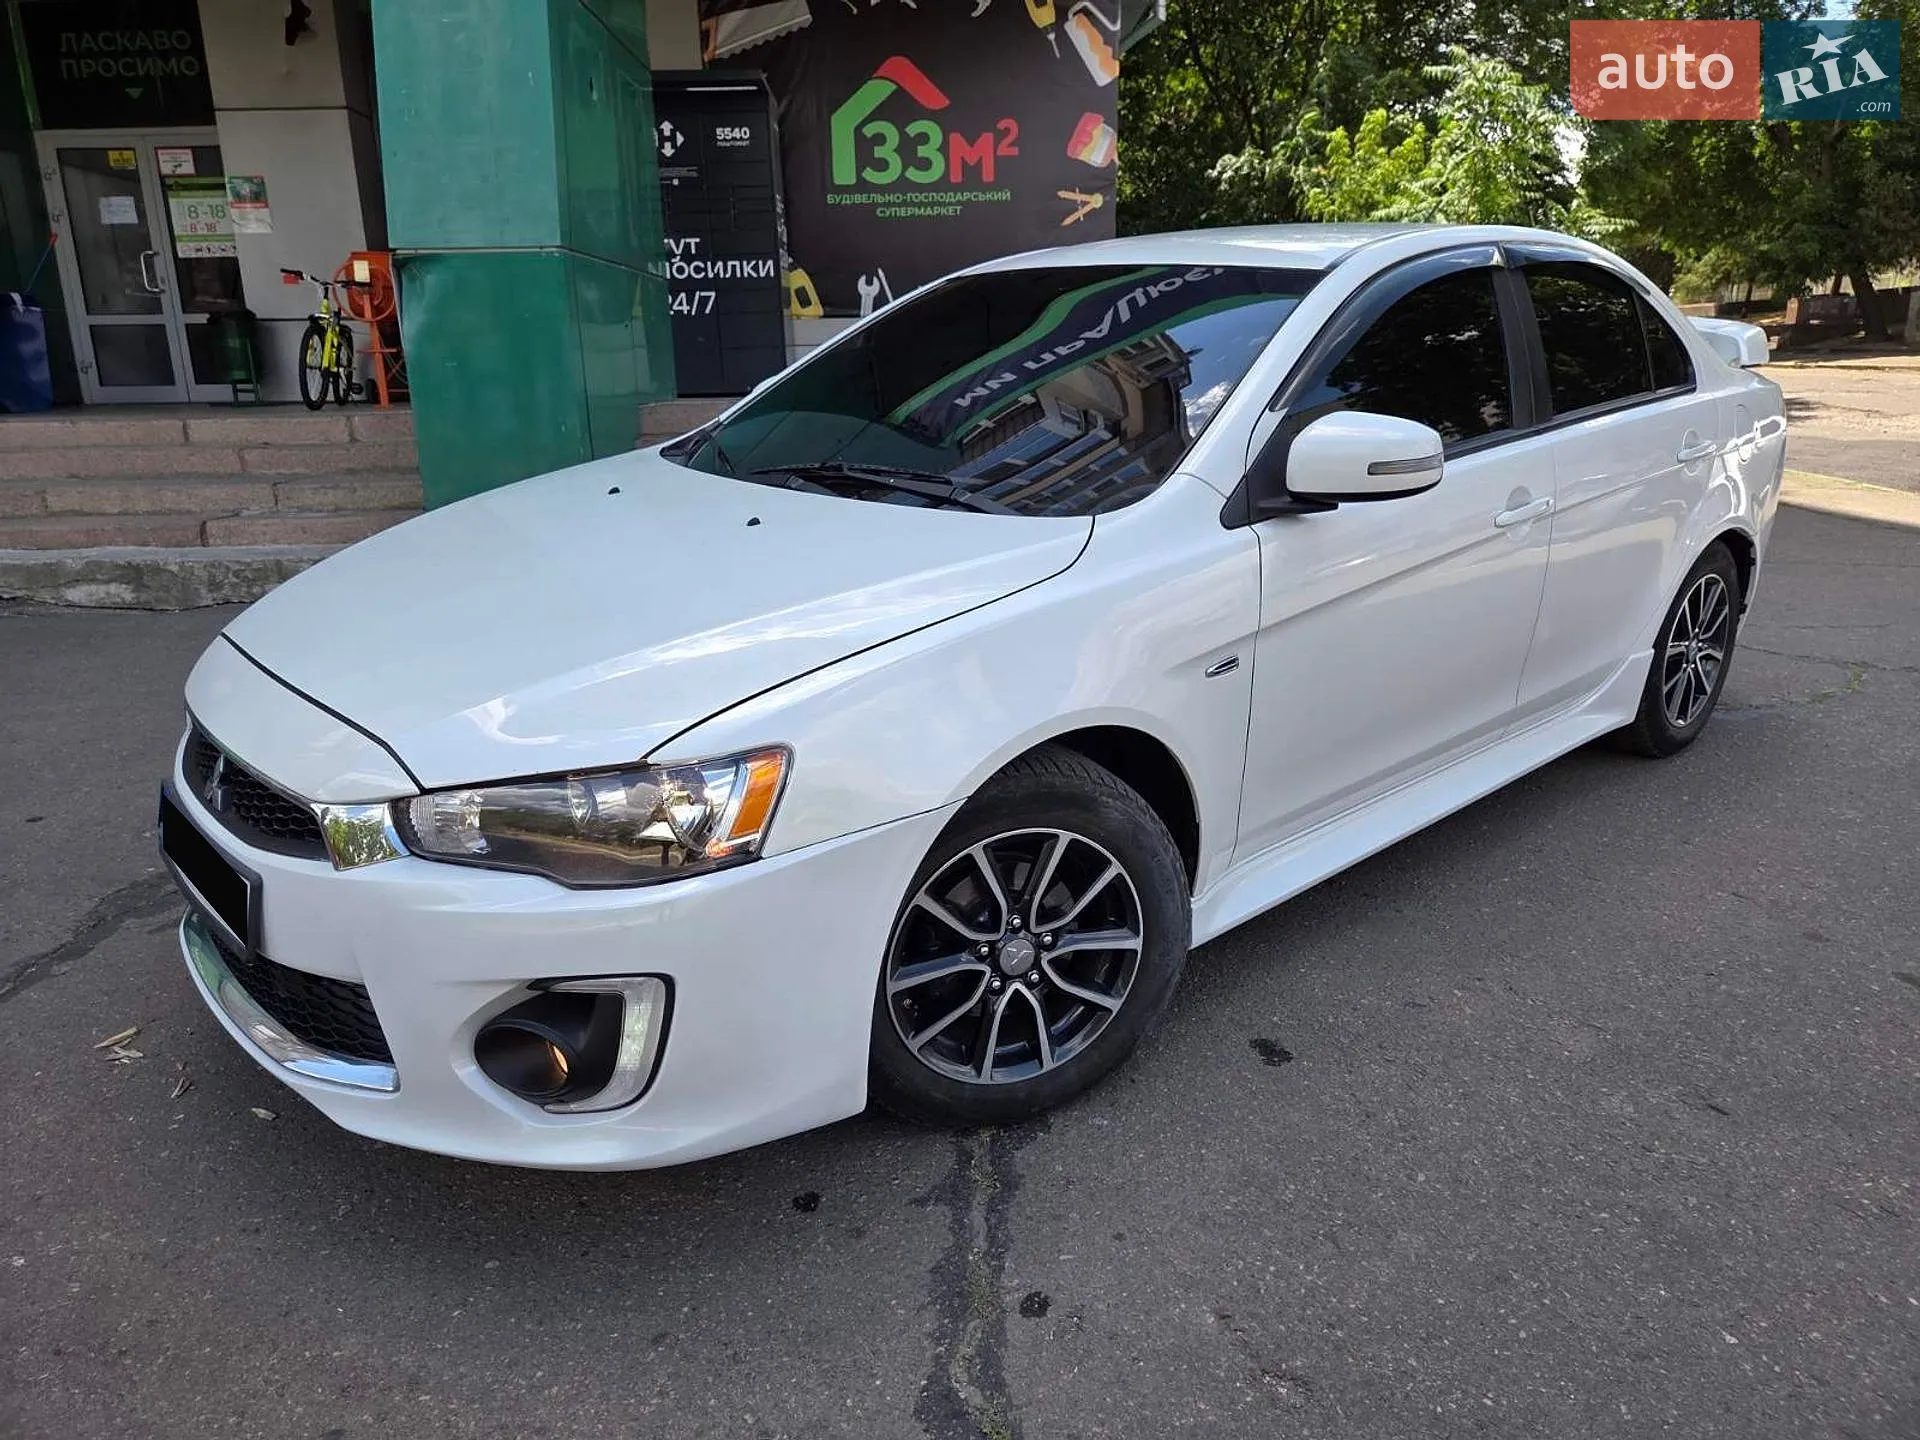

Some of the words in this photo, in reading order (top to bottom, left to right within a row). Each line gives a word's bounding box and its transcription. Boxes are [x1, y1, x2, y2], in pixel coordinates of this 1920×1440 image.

[60, 29, 192, 53] ЛАСКАВО
[60, 55, 200, 80] ПРОСИМО
[715, 127, 750, 140] 5540
[826, 189, 1011, 205] БУДІВЕЛЬНО-ГОСПОДАРСЬКИЙ
[876, 205, 963, 218] СУПЕРМАРКЕТ
